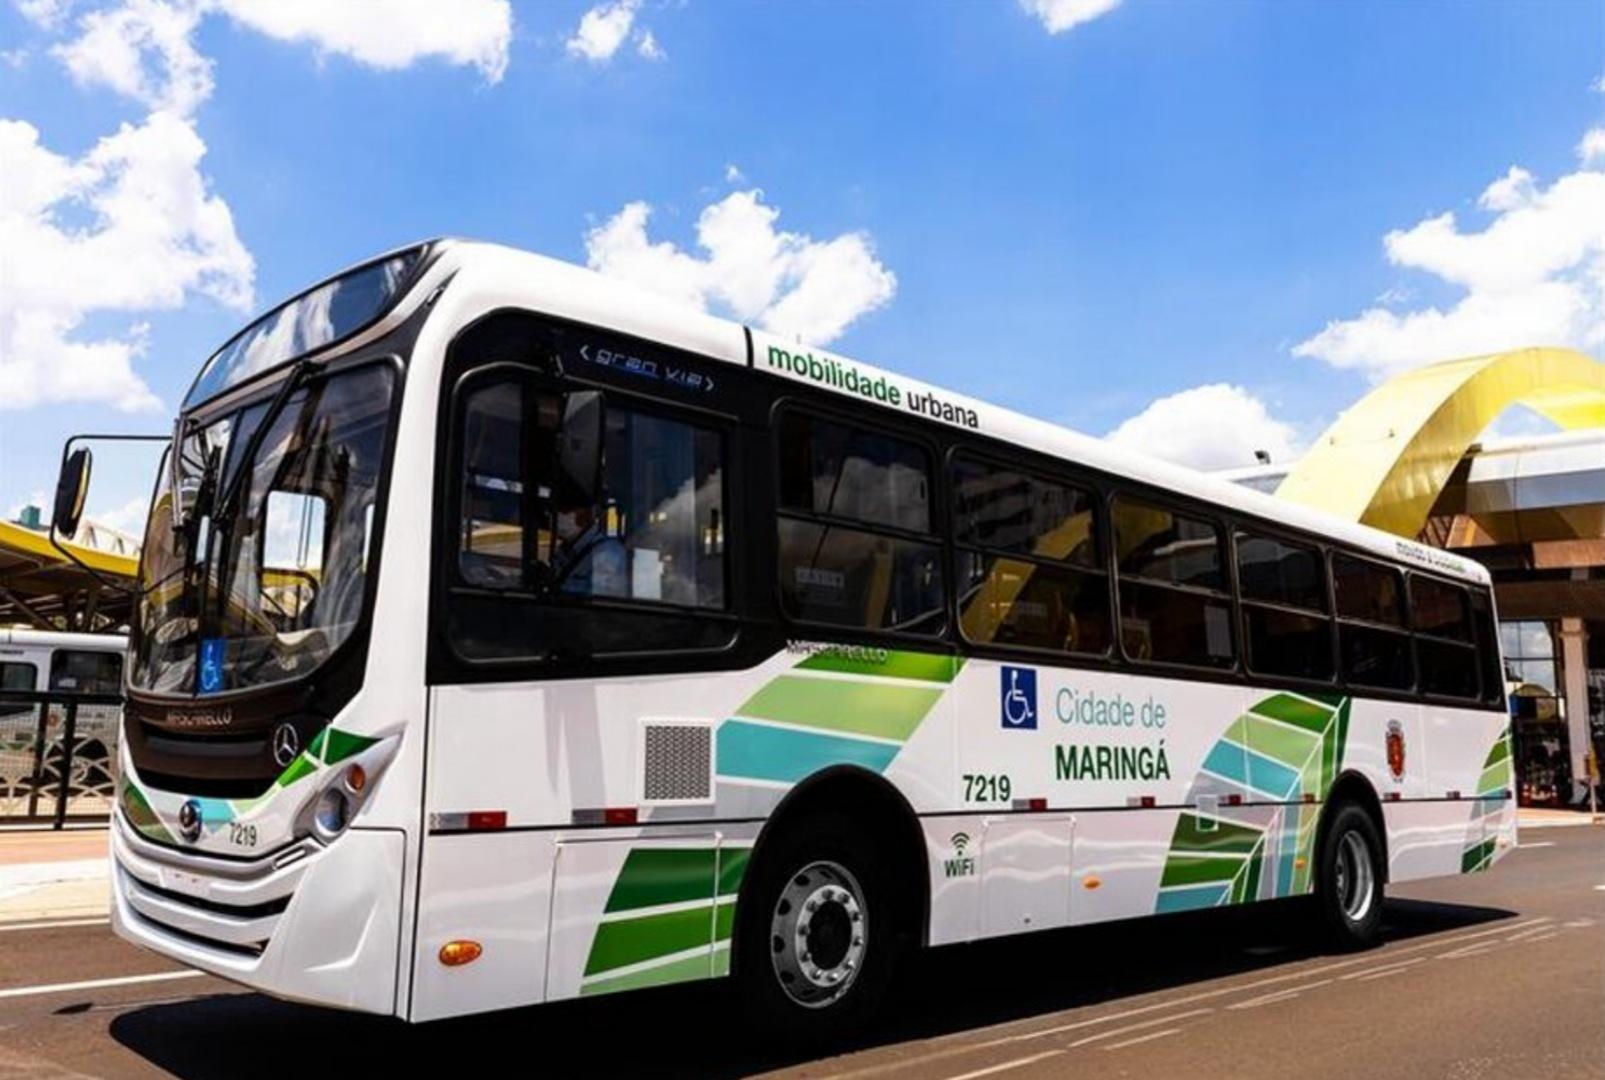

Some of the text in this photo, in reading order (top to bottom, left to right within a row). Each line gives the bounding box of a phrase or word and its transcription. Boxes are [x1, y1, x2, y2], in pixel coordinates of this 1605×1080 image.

[767, 344, 979, 428] mobilidade urbana
[1055, 687, 1166, 728] Cidade de
[1055, 739, 1171, 780] MARINGÁ
[962, 774, 1011, 802] 7219
[229, 822, 257, 847] 7219
[944, 858, 975, 877] WiFi
